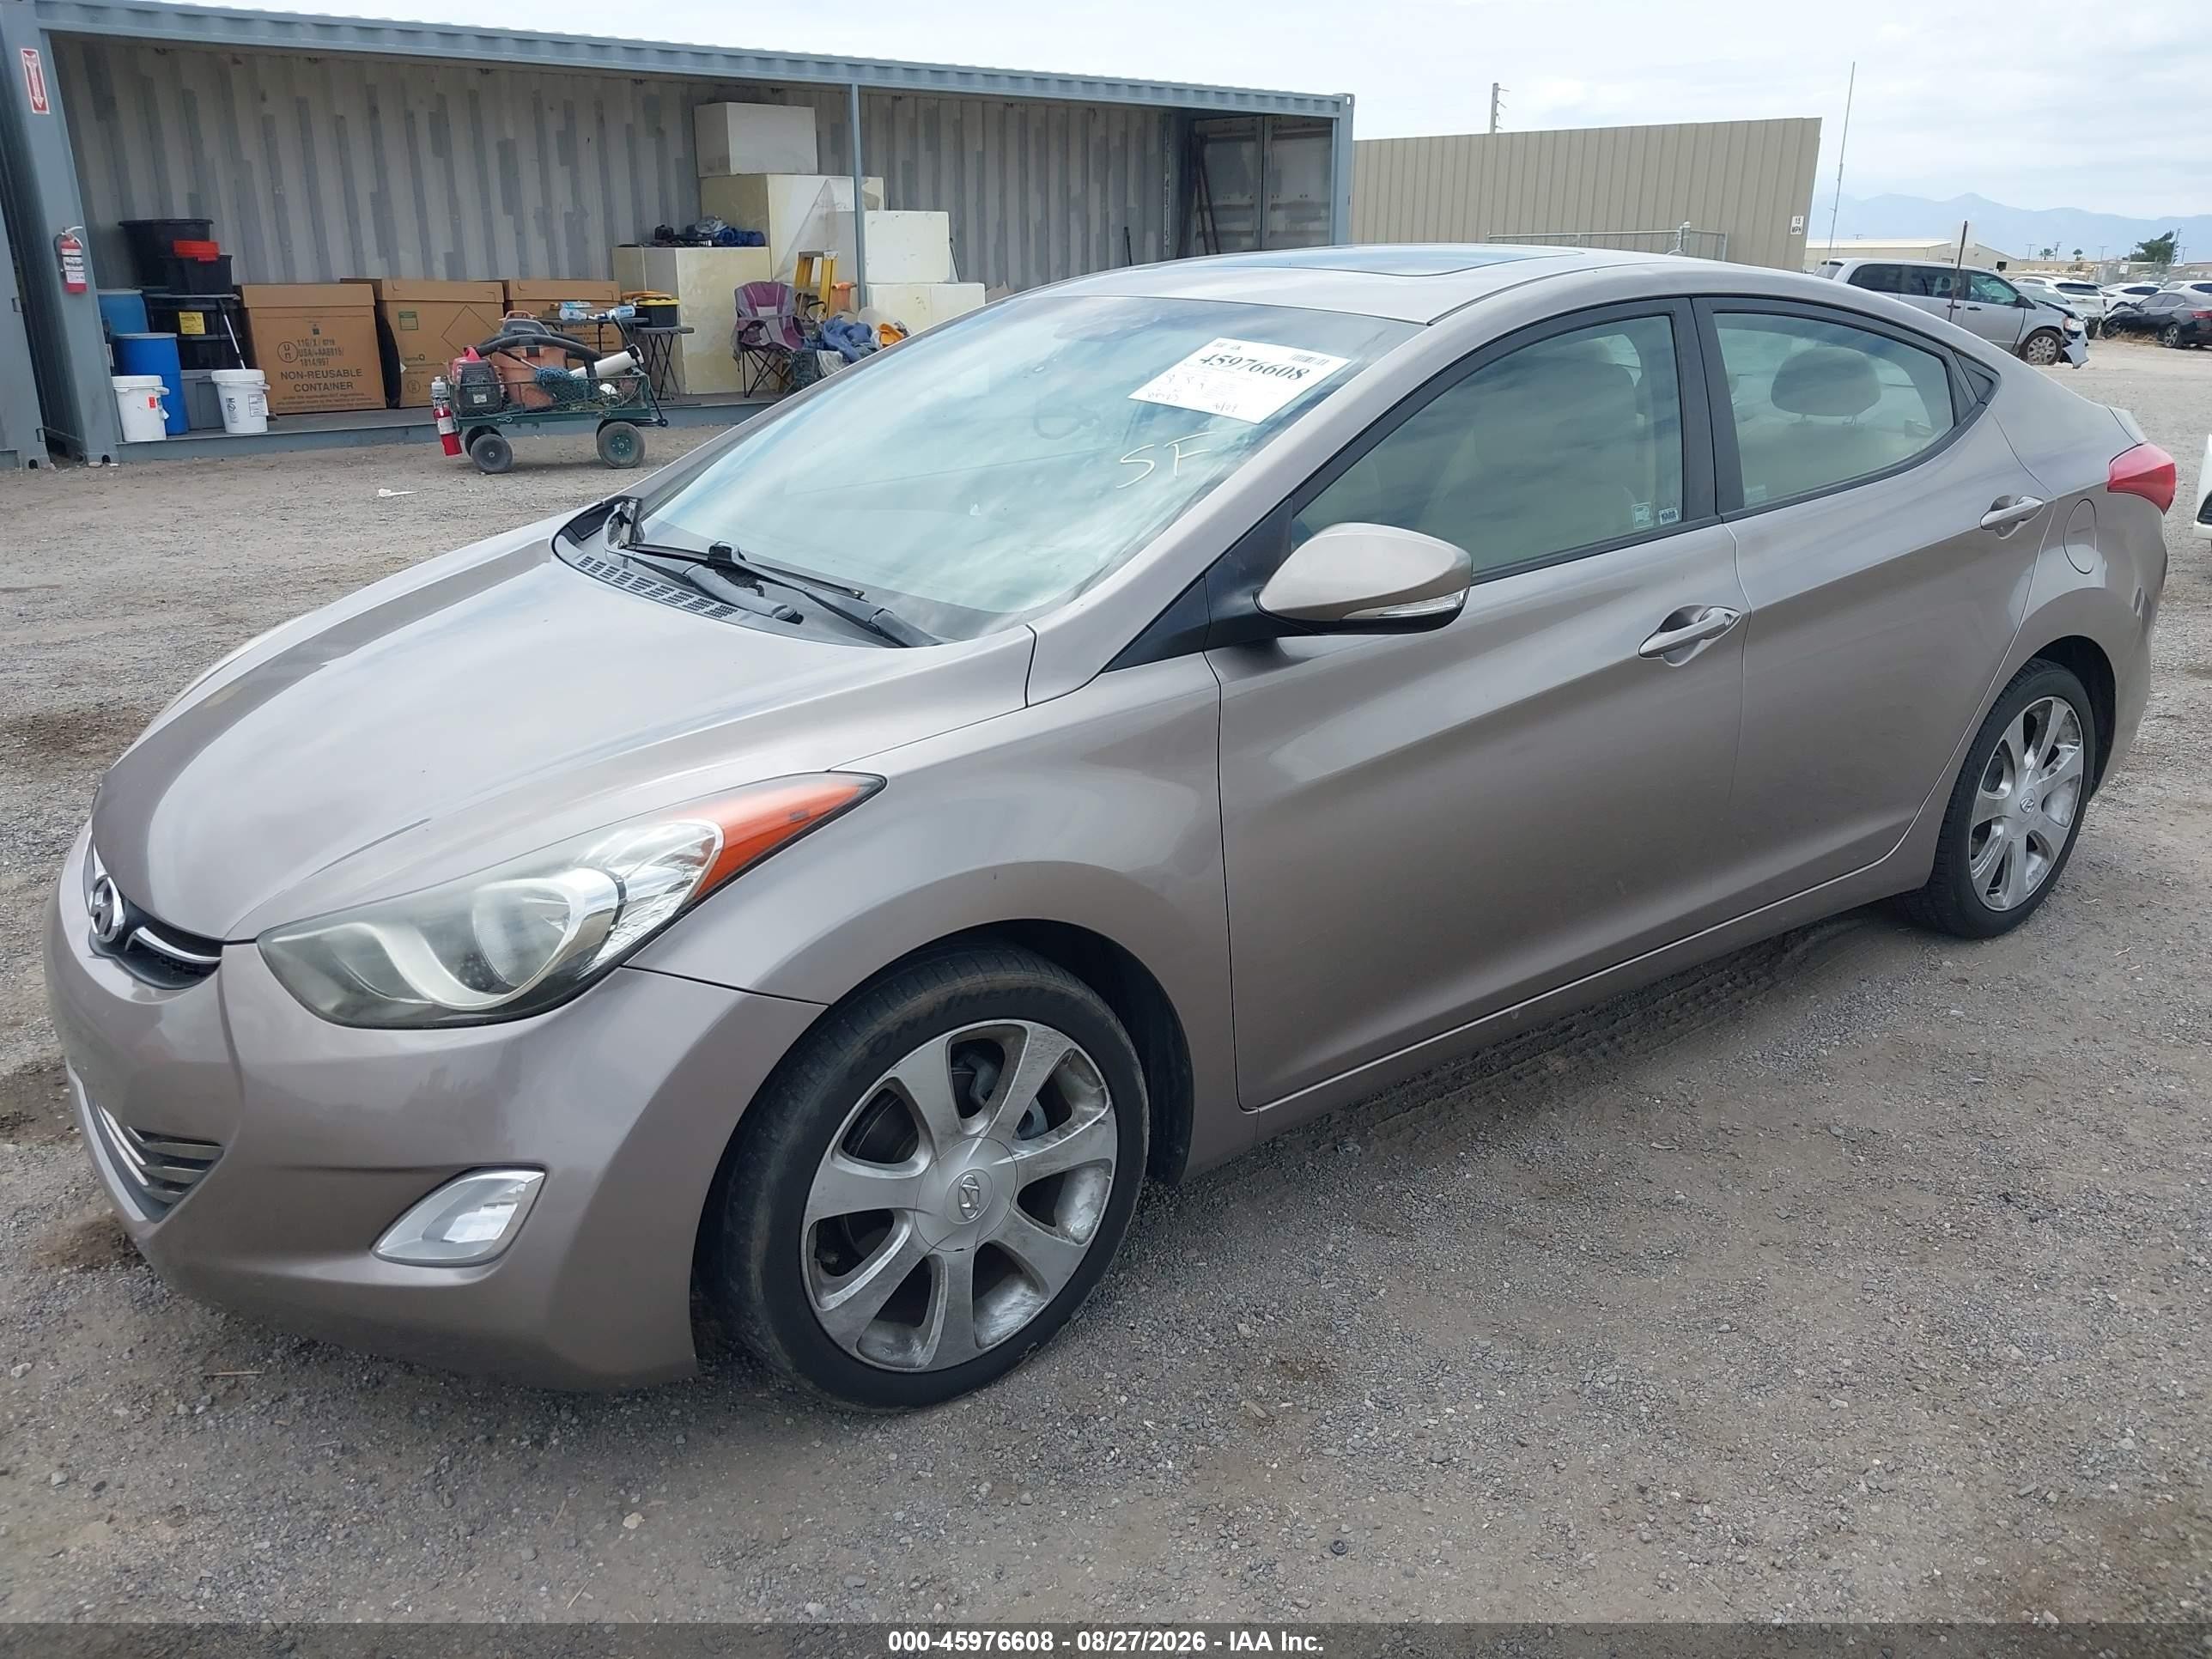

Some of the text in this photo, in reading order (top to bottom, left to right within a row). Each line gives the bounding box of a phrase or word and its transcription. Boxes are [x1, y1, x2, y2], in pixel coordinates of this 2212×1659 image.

[1200, 353, 1310, 380] 45976608
[280, 368, 363, 380] NON-REUSABLE
[293, 381, 354, 392] CONTAINER
